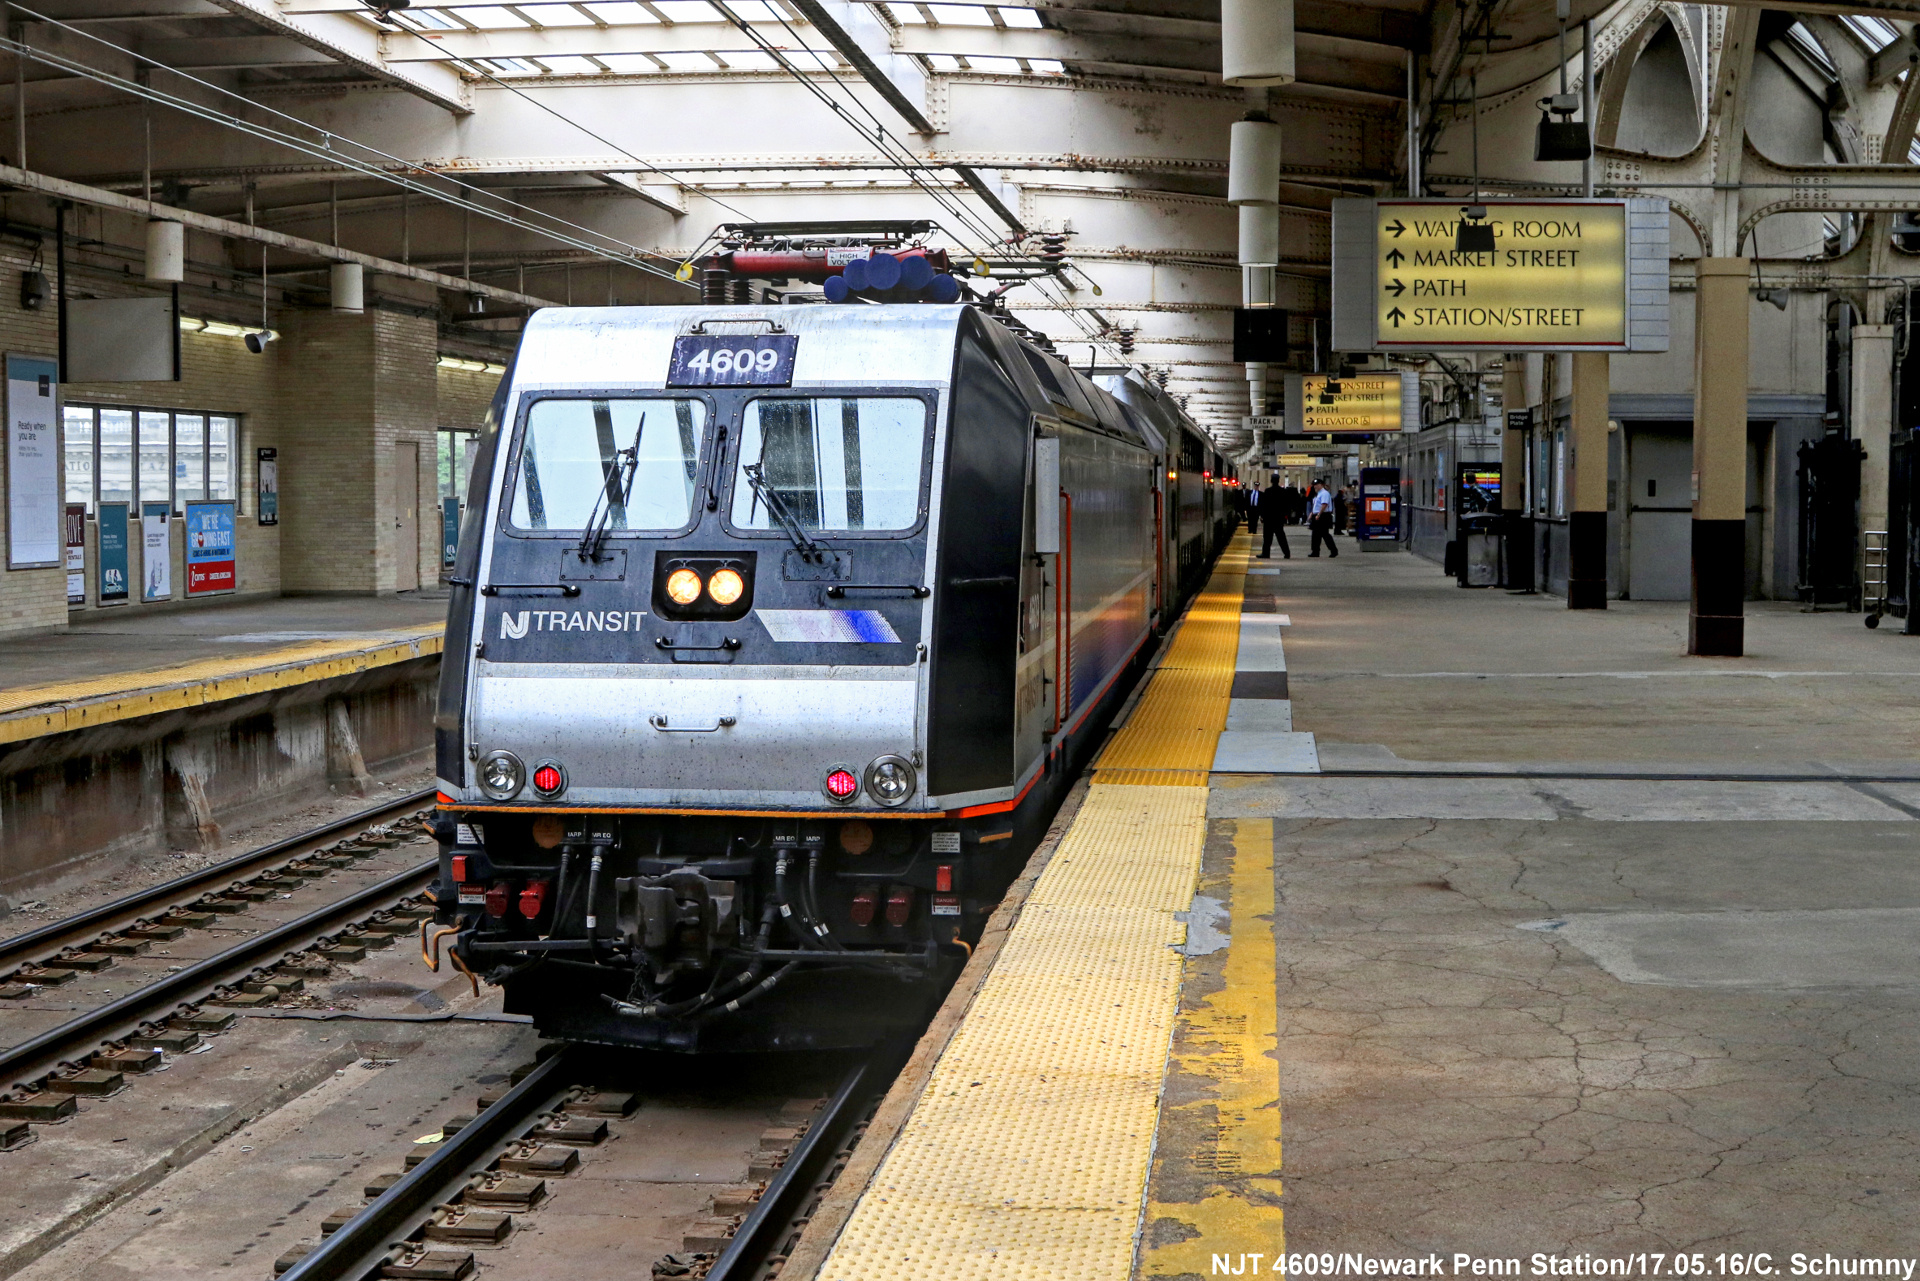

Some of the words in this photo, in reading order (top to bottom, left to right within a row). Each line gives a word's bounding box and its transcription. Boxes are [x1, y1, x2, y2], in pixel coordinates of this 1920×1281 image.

[1414, 220, 1503, 237] WAIG
[1513, 220, 1582, 238] ROOM
[1414, 249, 1499, 267] MARKET
[1506, 249, 1580, 268] STREET
[1413, 279, 1466, 297] PATH
[1413, 308, 1584, 327] STATION/STREET
[687, 348, 779, 373] 4609
[1316, 381, 1384, 391] STON/STREET
[1317, 394, 1352, 402] RKET
[1356, 393, 1384, 402] STREET
[18, 421, 32, 431] Ready
[33, 422, 47, 430] when
[1316, 417, 1359, 425] ELEVATOR
[18, 433, 27, 441] you
[67, 514, 81, 543] OVE
[217, 531, 230, 547] FAST
[500, 611, 530, 639] NJ
[533, 611, 648, 632] TRANSIT
